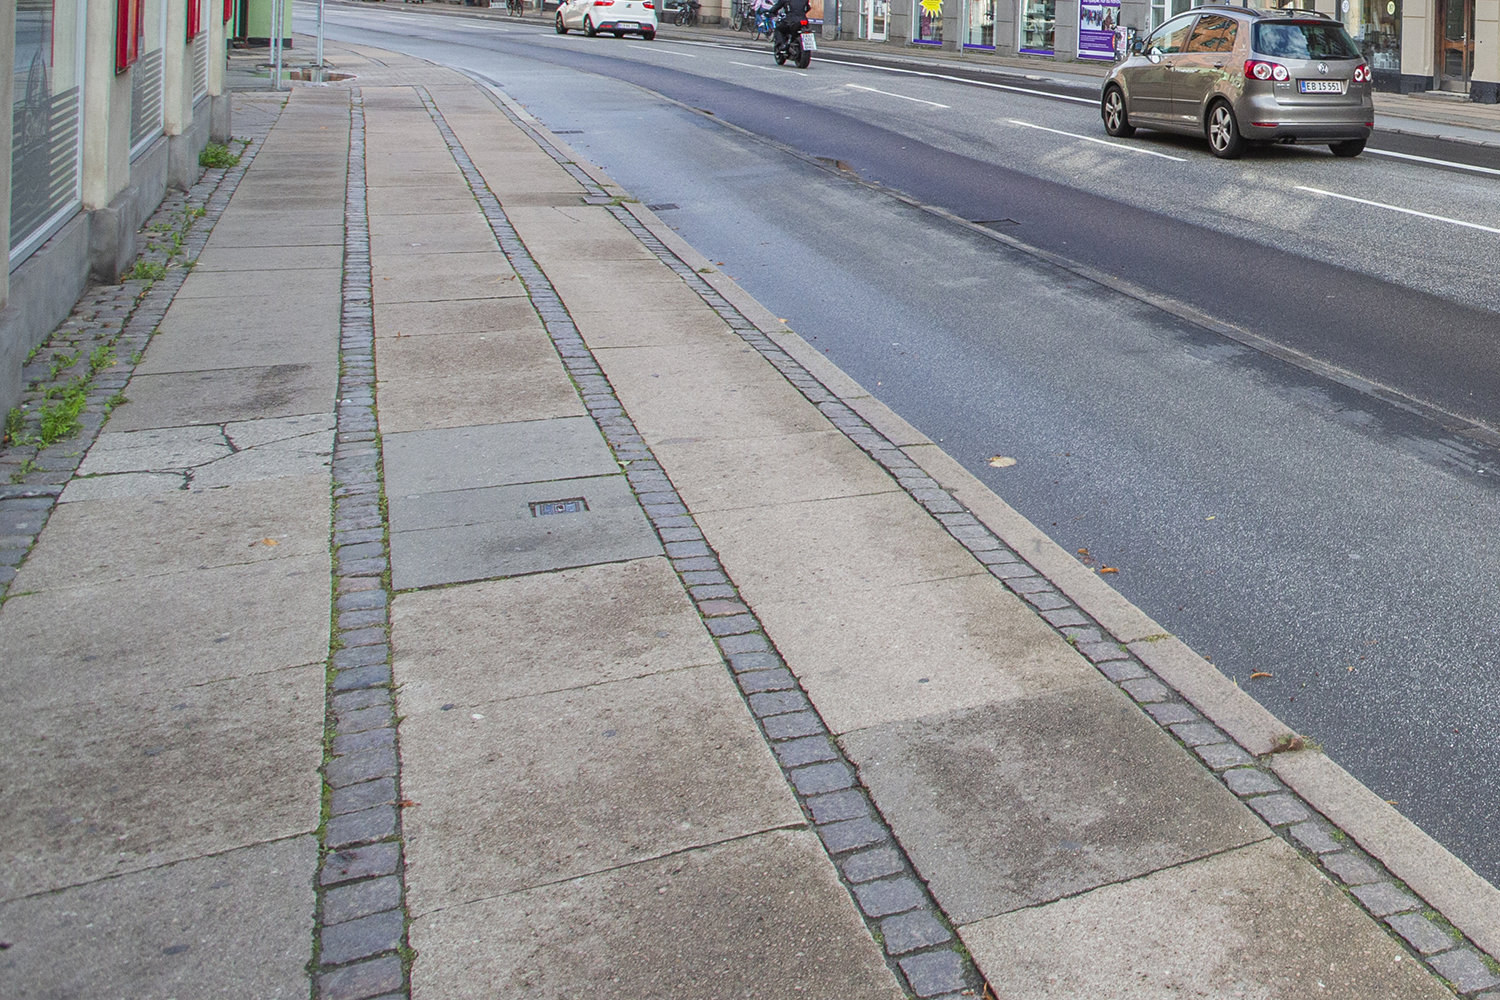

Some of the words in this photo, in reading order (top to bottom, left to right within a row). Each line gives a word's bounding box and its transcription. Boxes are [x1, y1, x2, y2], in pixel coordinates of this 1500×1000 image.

[1306, 82, 1317, 91] EB
[1319, 82, 1327, 91] 15
[1328, 82, 1340, 91] 551
